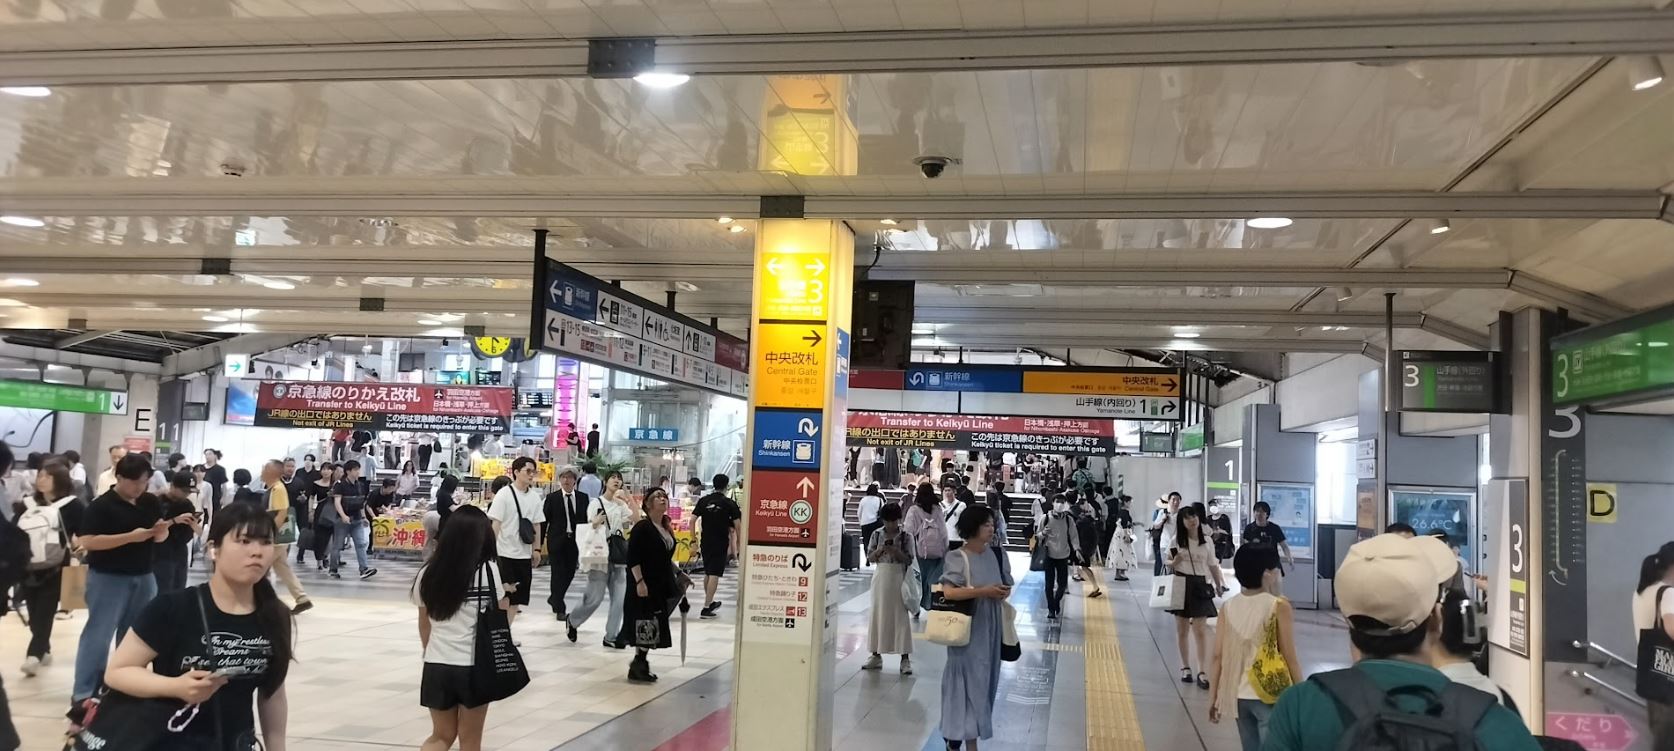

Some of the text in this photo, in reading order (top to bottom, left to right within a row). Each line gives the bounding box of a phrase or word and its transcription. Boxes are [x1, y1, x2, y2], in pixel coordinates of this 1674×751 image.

[808, 279, 824, 304] 3
[765, 351, 819, 365] 中央改札
[766, 367, 818, 376] Central Gate
[944, 372, 970, 381] 新幹線
[1404, 364, 1420, 387] 3
[1557, 353, 1568, 398] 3
[1122, 376, 1159, 385] 中央改札
[287, 384, 421, 402] 京急線のりかえ改札
[99, 394, 106, 410] 1
[307, 400, 343, 410] Transfer
[344, 402, 354, 410] to
[387, 403, 407, 411] Line
[1140, 399, 1146, 414] 1
[135, 409, 151, 431] E
[267, 409, 373, 421] JR線の出口ではありません
[386, 414, 499, 425] この先は京急線のきっぷが必要です
[430, 423, 455, 431] required
[880, 417, 921, 426] Transfer
[924, 418, 932, 427] to
[972, 420, 994, 429] Line
[159, 422, 166, 440] 1
[173, 423, 179, 440] 1
[634, 429, 673, 440] 京急線
[846, 428, 956, 439] R線の出口ではありません
[763, 440, 791, 450] 新幹線
[880, 438, 893, 446] exit
[971, 432, 1100, 446] この先は京急線のきっぷが必要です
[1021, 443, 1049, 452] required
[1225, 460, 1234, 480] 1
[760, 499, 788, 511] 京急線
[1590, 489, 1615, 517] D
[793, 507, 808, 517] KK
[1412, 518, 1453, 530] 26.6°C
[1511, 523, 1523, 573] 3
[752, 553, 789, 563] 特急のりば
[799, 592, 808, 601] 12
[798, 607, 807, 616] 13
[1554, 716, 1612, 733] くだり
